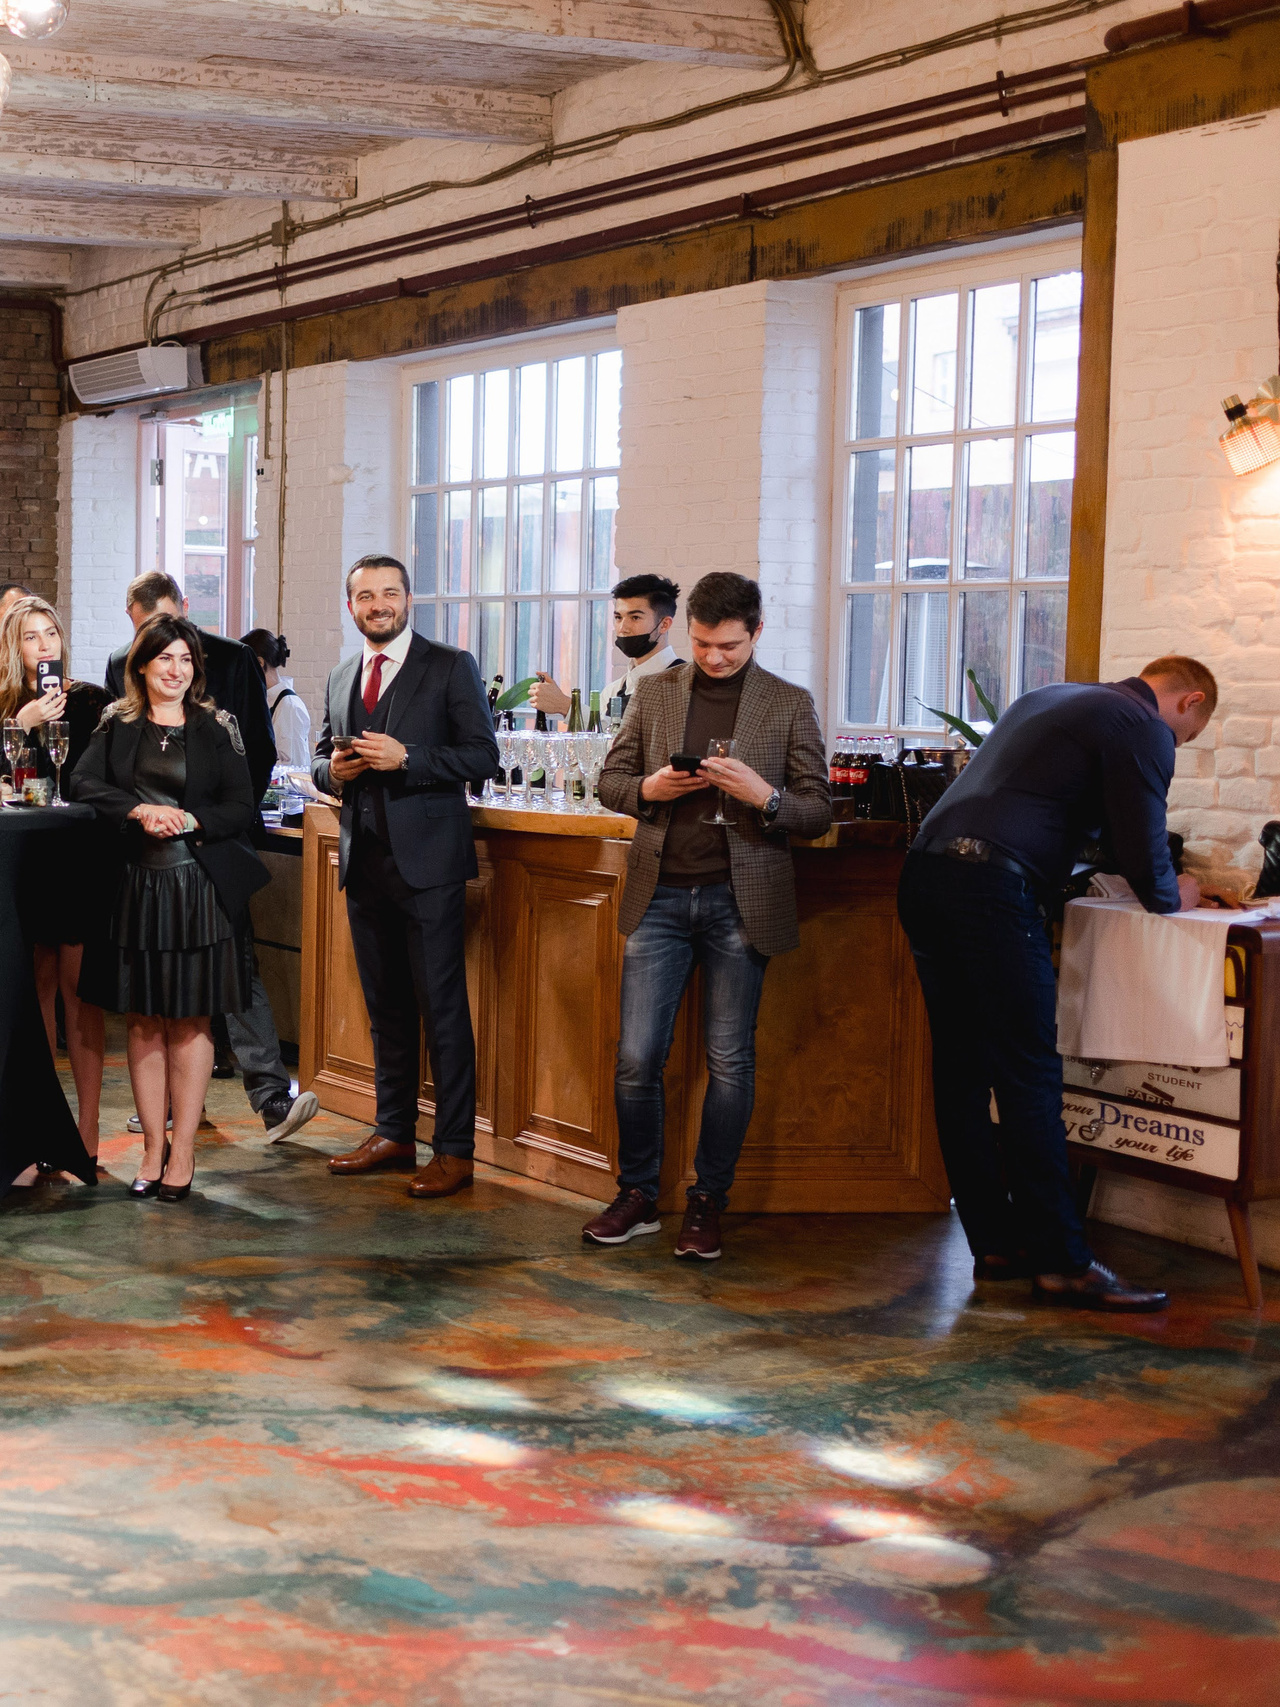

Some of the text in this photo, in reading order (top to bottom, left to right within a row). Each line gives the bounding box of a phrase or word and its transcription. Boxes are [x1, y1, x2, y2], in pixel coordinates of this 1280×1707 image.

[1147, 1072, 1203, 1090] STUDENT
[1098, 1101, 1206, 1146] Dreams
[1109, 1136, 1158, 1153] your
[1165, 1144, 1195, 1162] life
